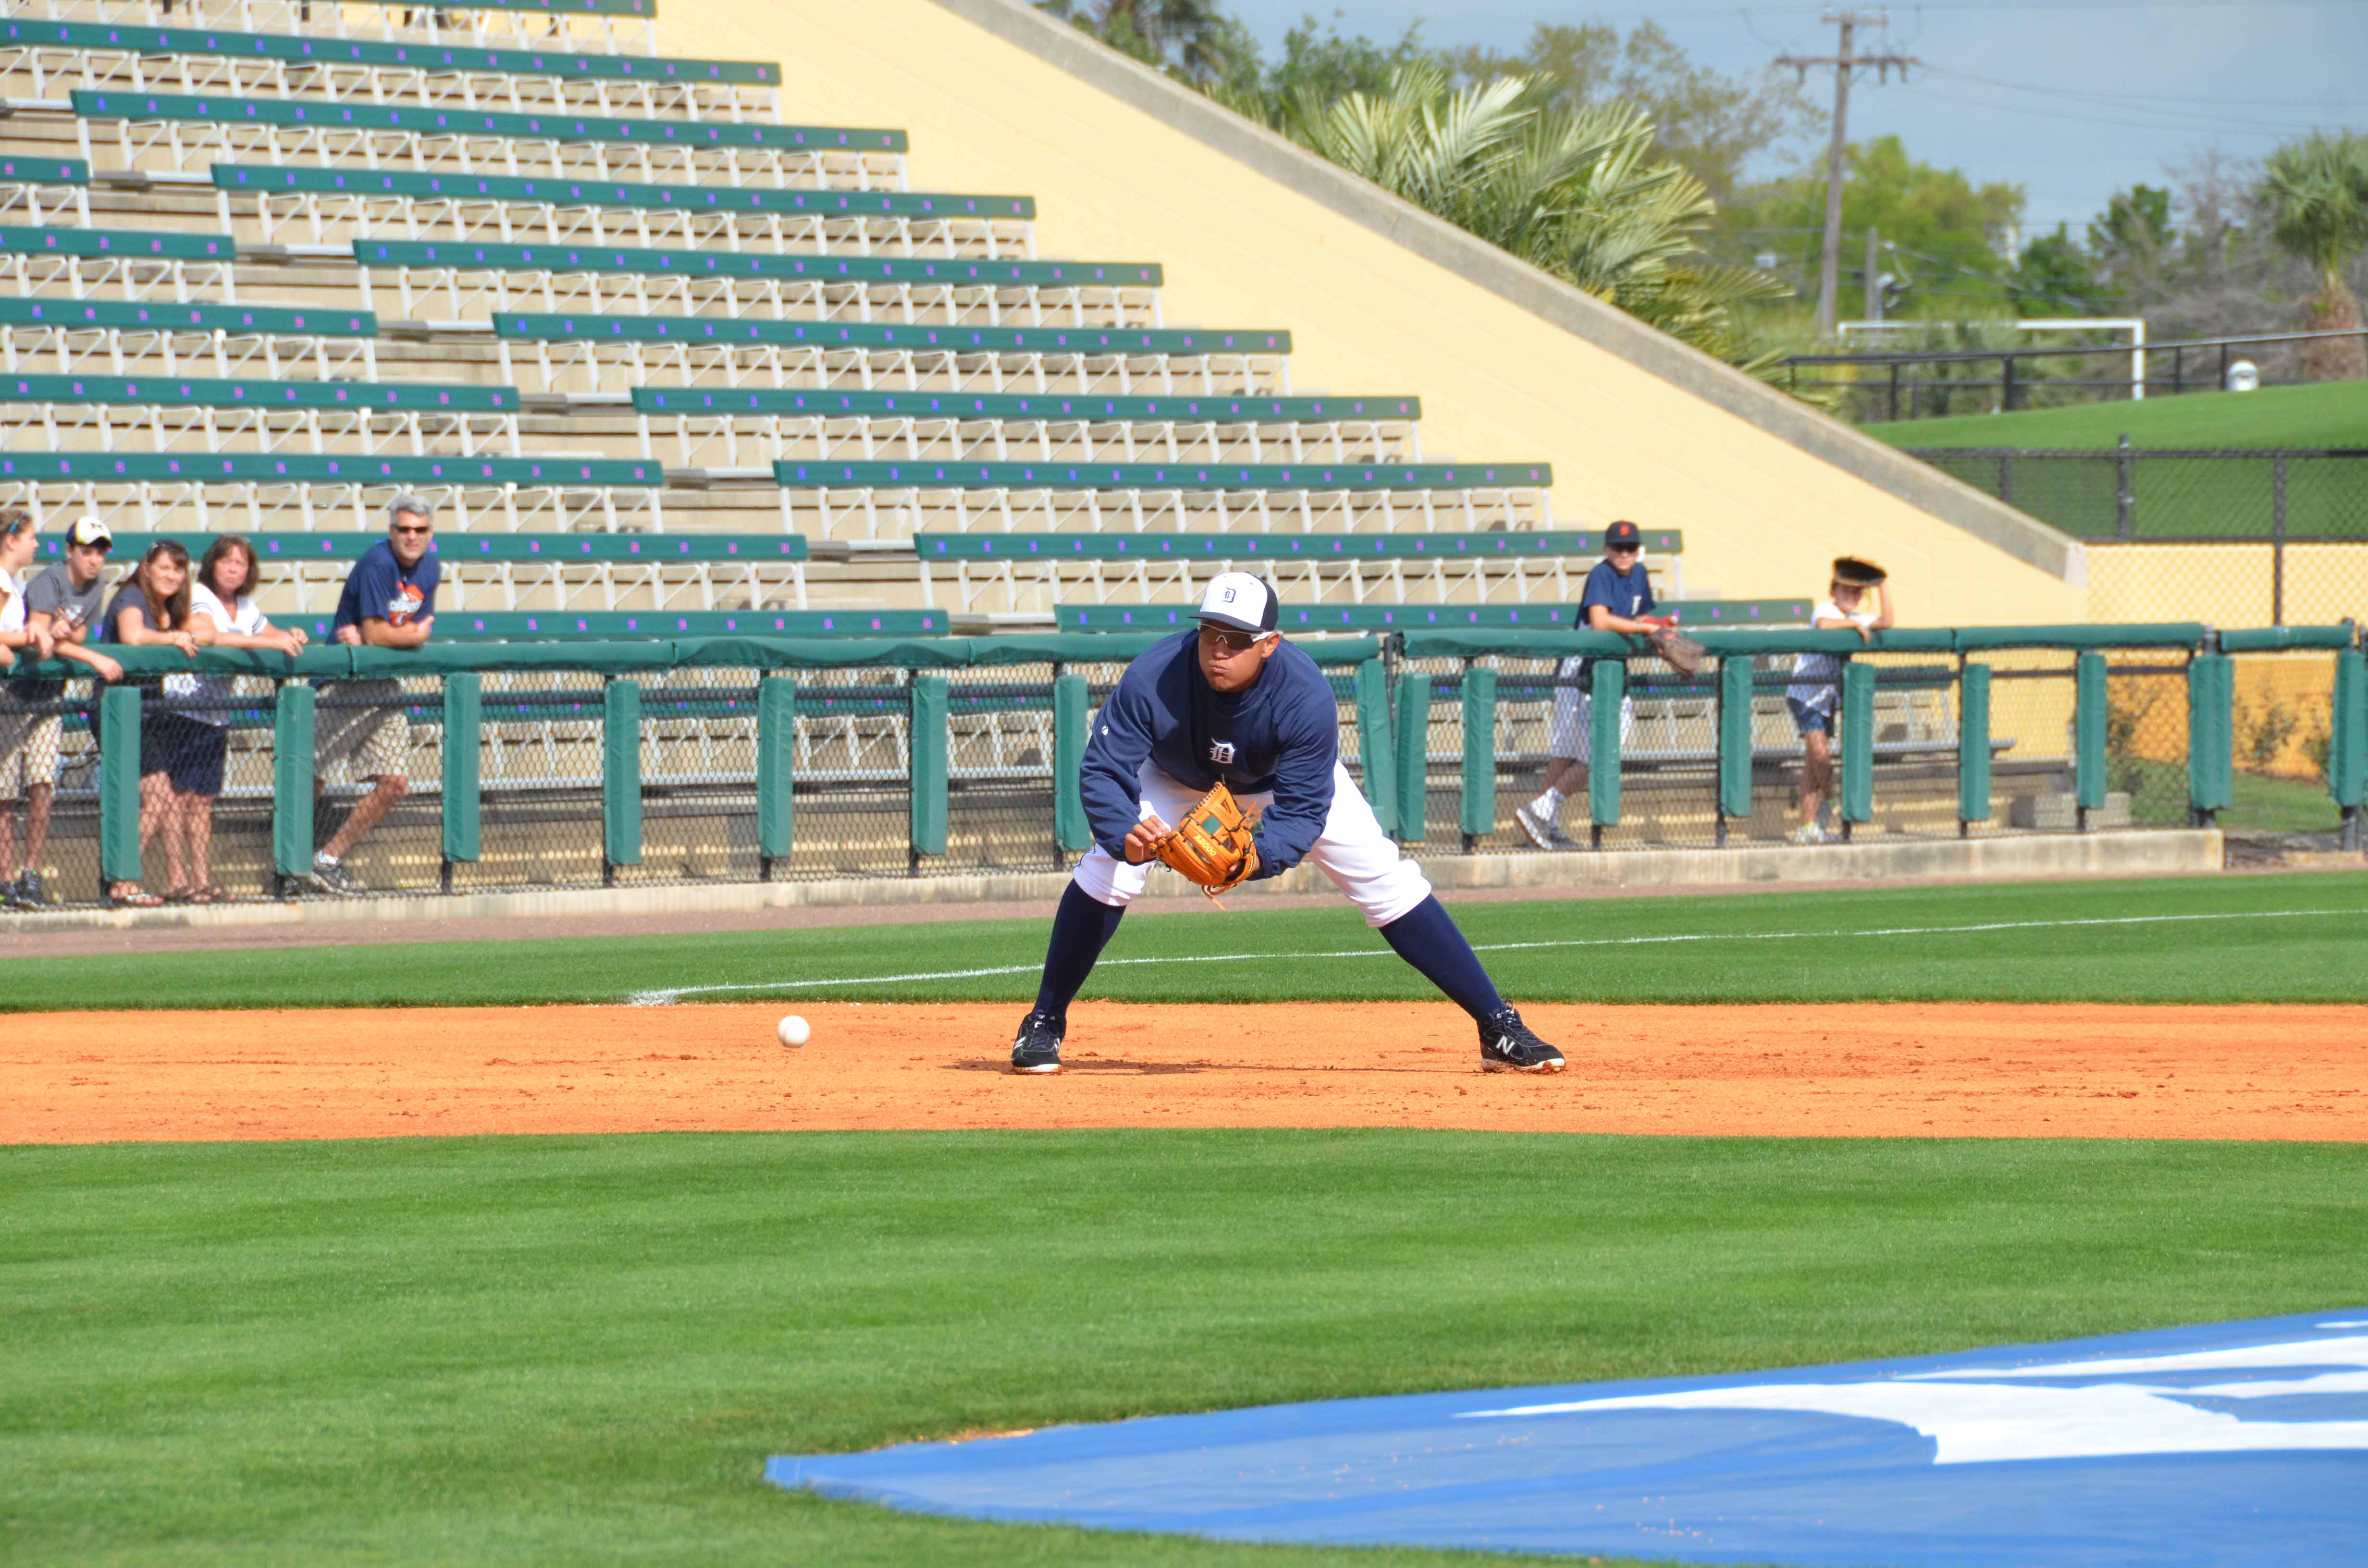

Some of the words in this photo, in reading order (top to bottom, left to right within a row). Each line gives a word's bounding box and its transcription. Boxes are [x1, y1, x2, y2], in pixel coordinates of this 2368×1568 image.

[1221, 587, 1236, 603] D
[1209, 736, 1235, 764] D
[1193, 834, 1217, 856] A2000
[1495, 1034, 1516, 1055] N
